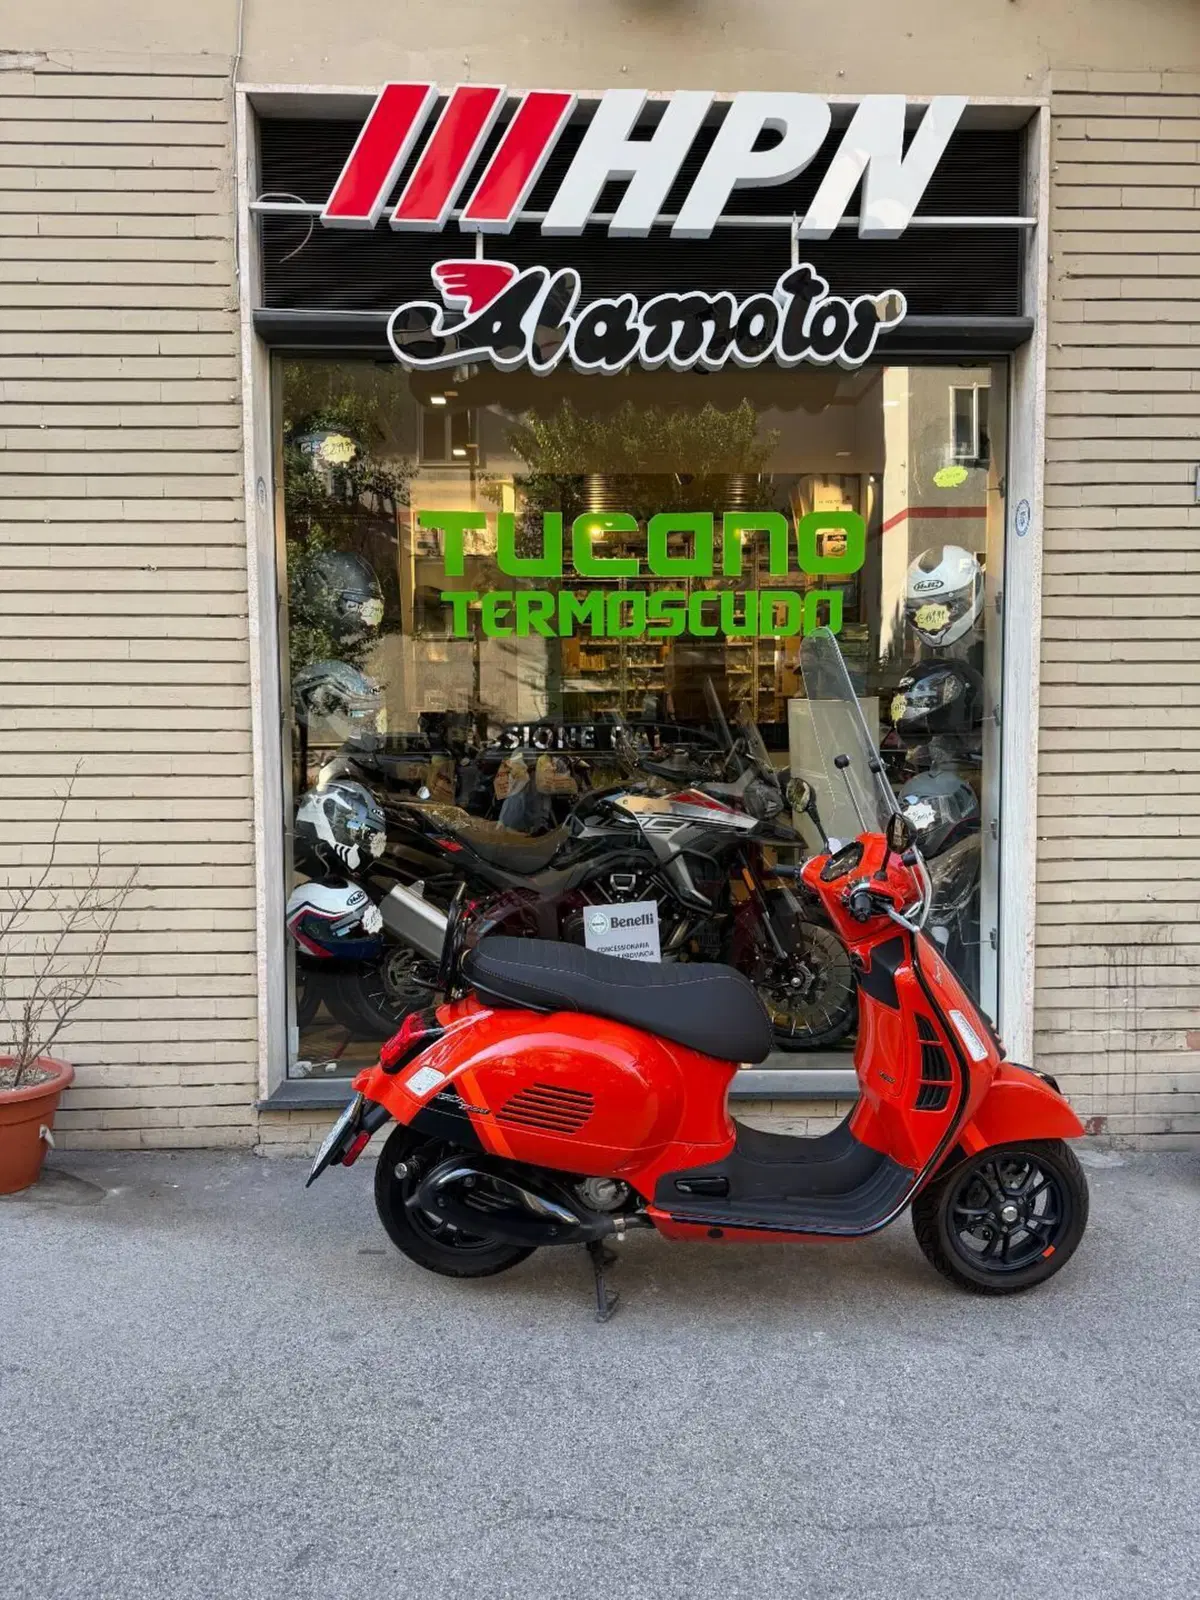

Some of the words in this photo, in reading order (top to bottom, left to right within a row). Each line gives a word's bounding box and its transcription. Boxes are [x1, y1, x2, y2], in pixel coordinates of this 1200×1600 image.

[541, 88, 968, 239] HPN
[387, 259, 908, 376] Alamotor
[441, 590, 844, 638] TERMOSCUDO
[610, 913, 654, 928] Benelli
